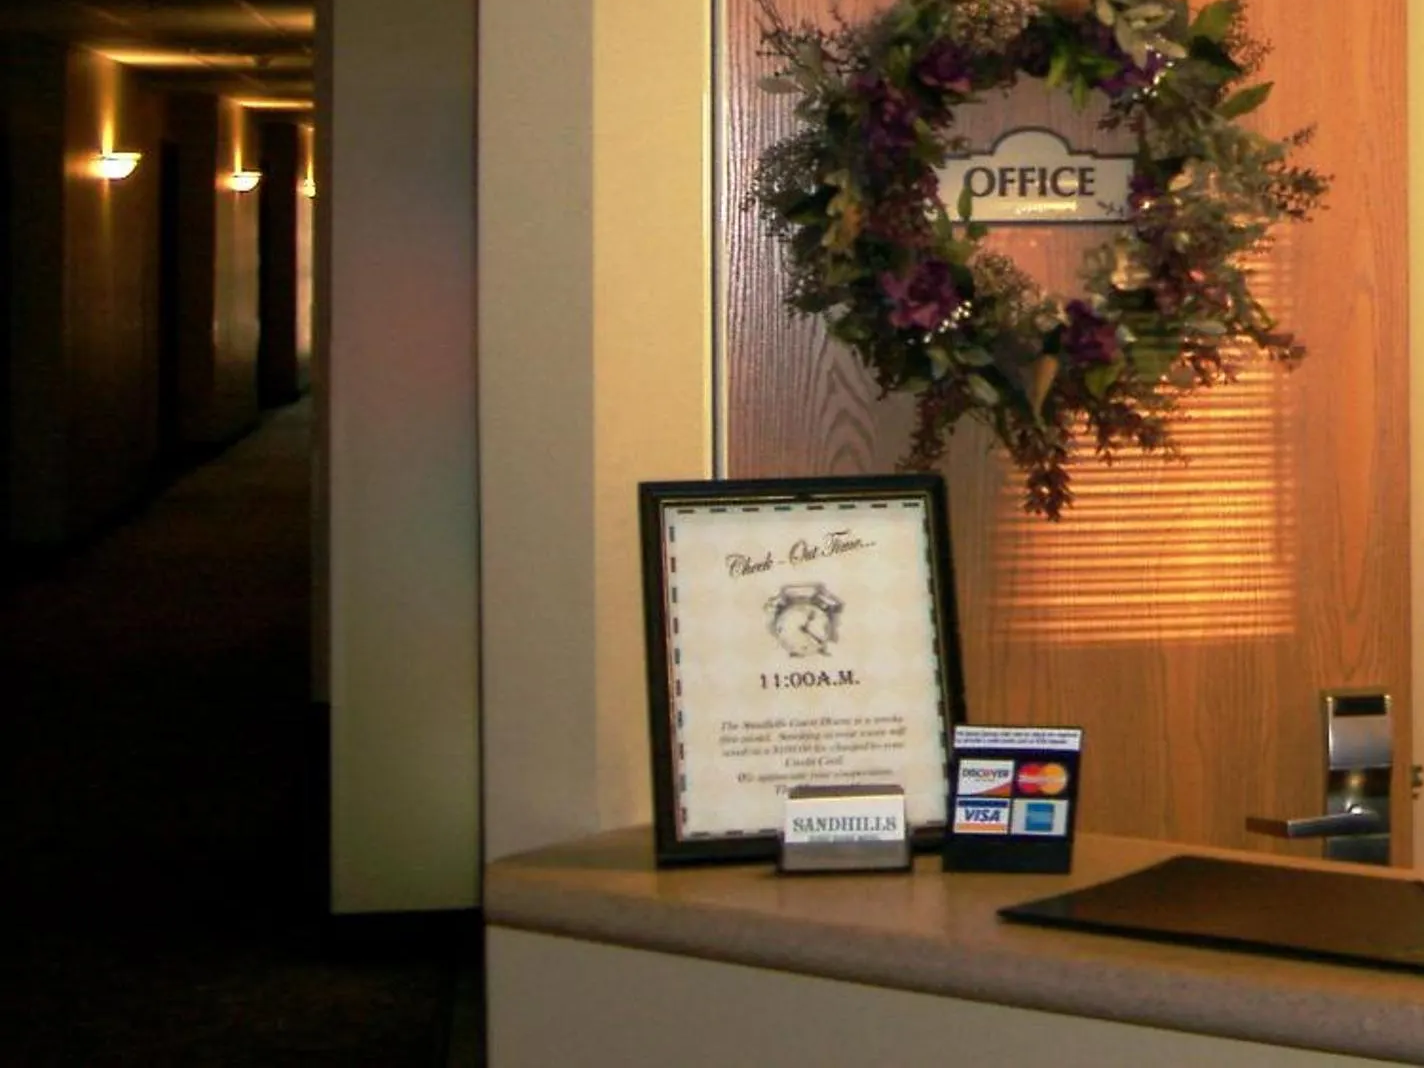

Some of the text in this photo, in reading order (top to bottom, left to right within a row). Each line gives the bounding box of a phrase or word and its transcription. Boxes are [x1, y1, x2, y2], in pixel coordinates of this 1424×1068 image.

[964, 167, 1095, 197] OFFICE
[963, 807, 1001, 822] VISA
[792, 816, 897, 832] SANDHILLS
